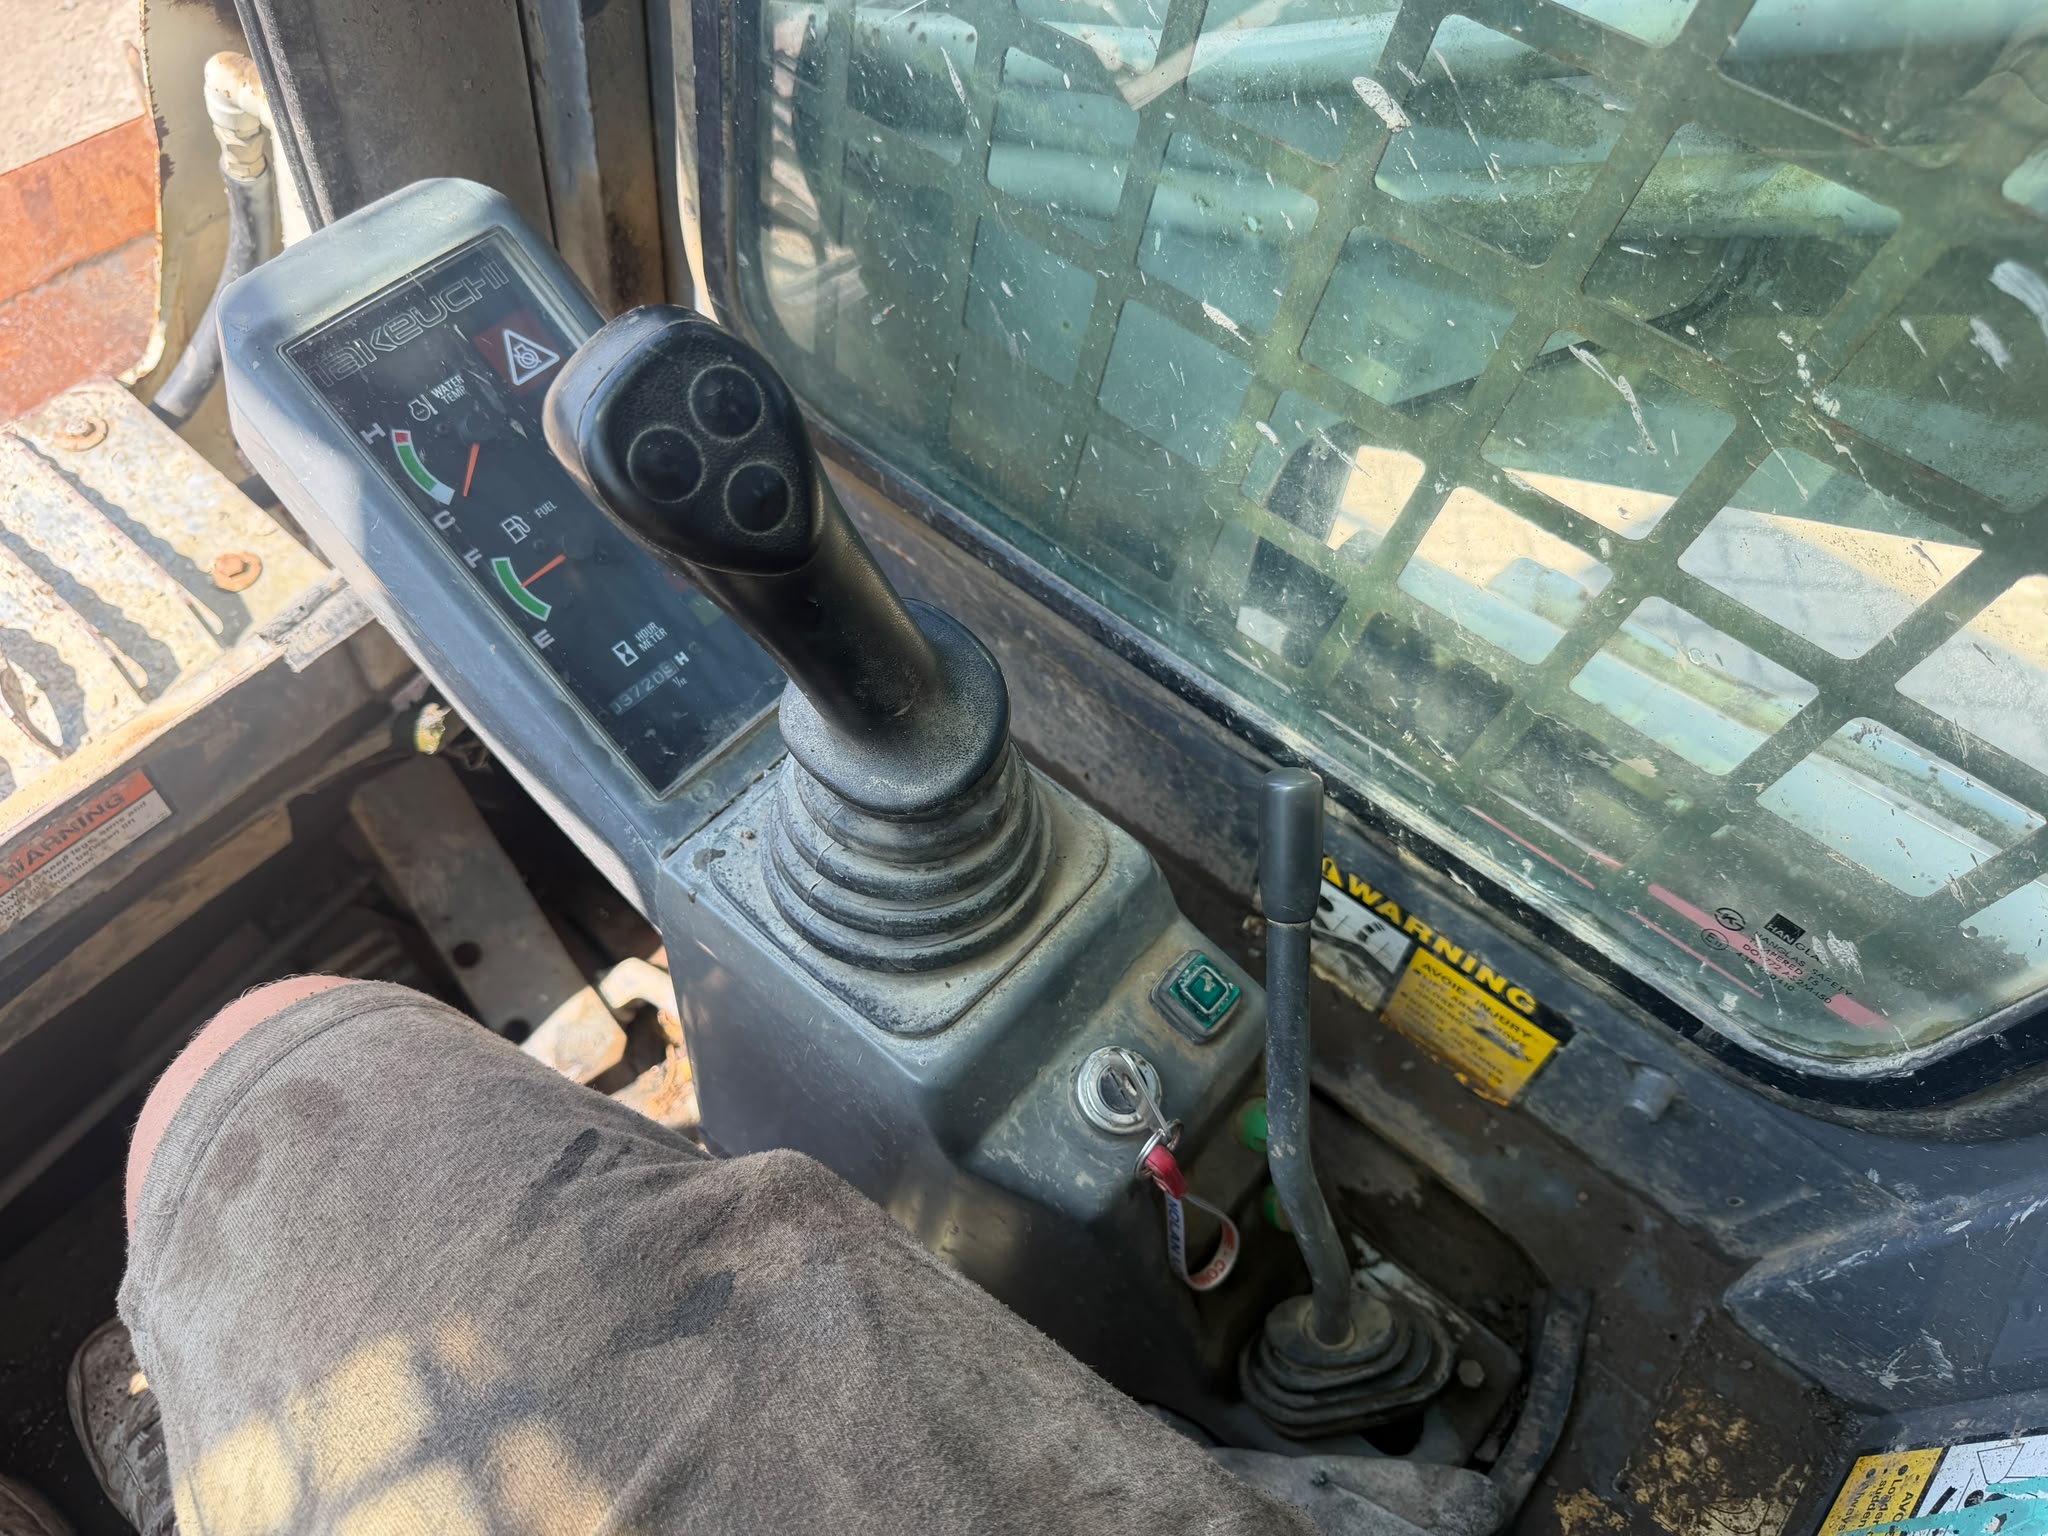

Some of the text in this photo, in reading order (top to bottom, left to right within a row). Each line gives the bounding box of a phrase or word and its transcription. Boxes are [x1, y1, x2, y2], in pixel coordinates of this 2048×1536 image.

[431, 374, 465, 399] WATER
[440, 385, 466, 405] TEMP
[359, 422, 386, 445] H
[432, 510, 456, 530] C
[534, 500, 557, 518] FUEL
[463, 547, 482, 569] F
[532, 628, 556, 649] E
[634, 622, 659, 642] HOUR
[638, 627, 668, 652] METER
[4, 793, 125, 880] WARNING
[1348, 872, 1538, 1014] WARNING
[1811, 968, 1853, 996] SAFETY
[1474, 999, 1532, 1039] INJURY
[1858, 1480, 1887, 1528] sudden
[1892, 1491, 1914, 1523] AVO
